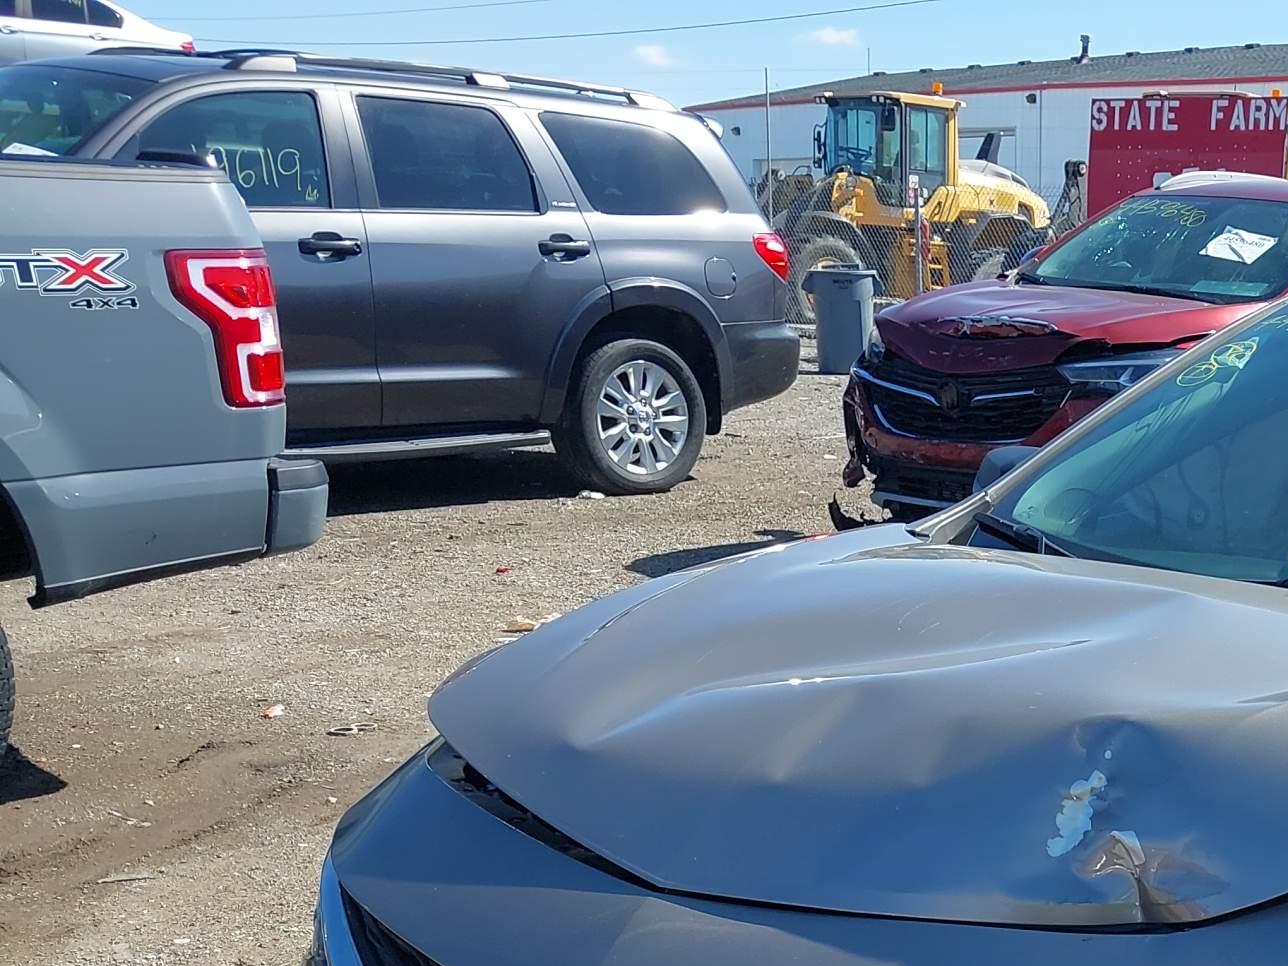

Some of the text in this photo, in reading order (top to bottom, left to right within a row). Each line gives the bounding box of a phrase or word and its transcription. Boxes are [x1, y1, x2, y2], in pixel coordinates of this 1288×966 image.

[1091, 97, 1287, 132] STATE FARM
[0, 249, 136, 296] TX
